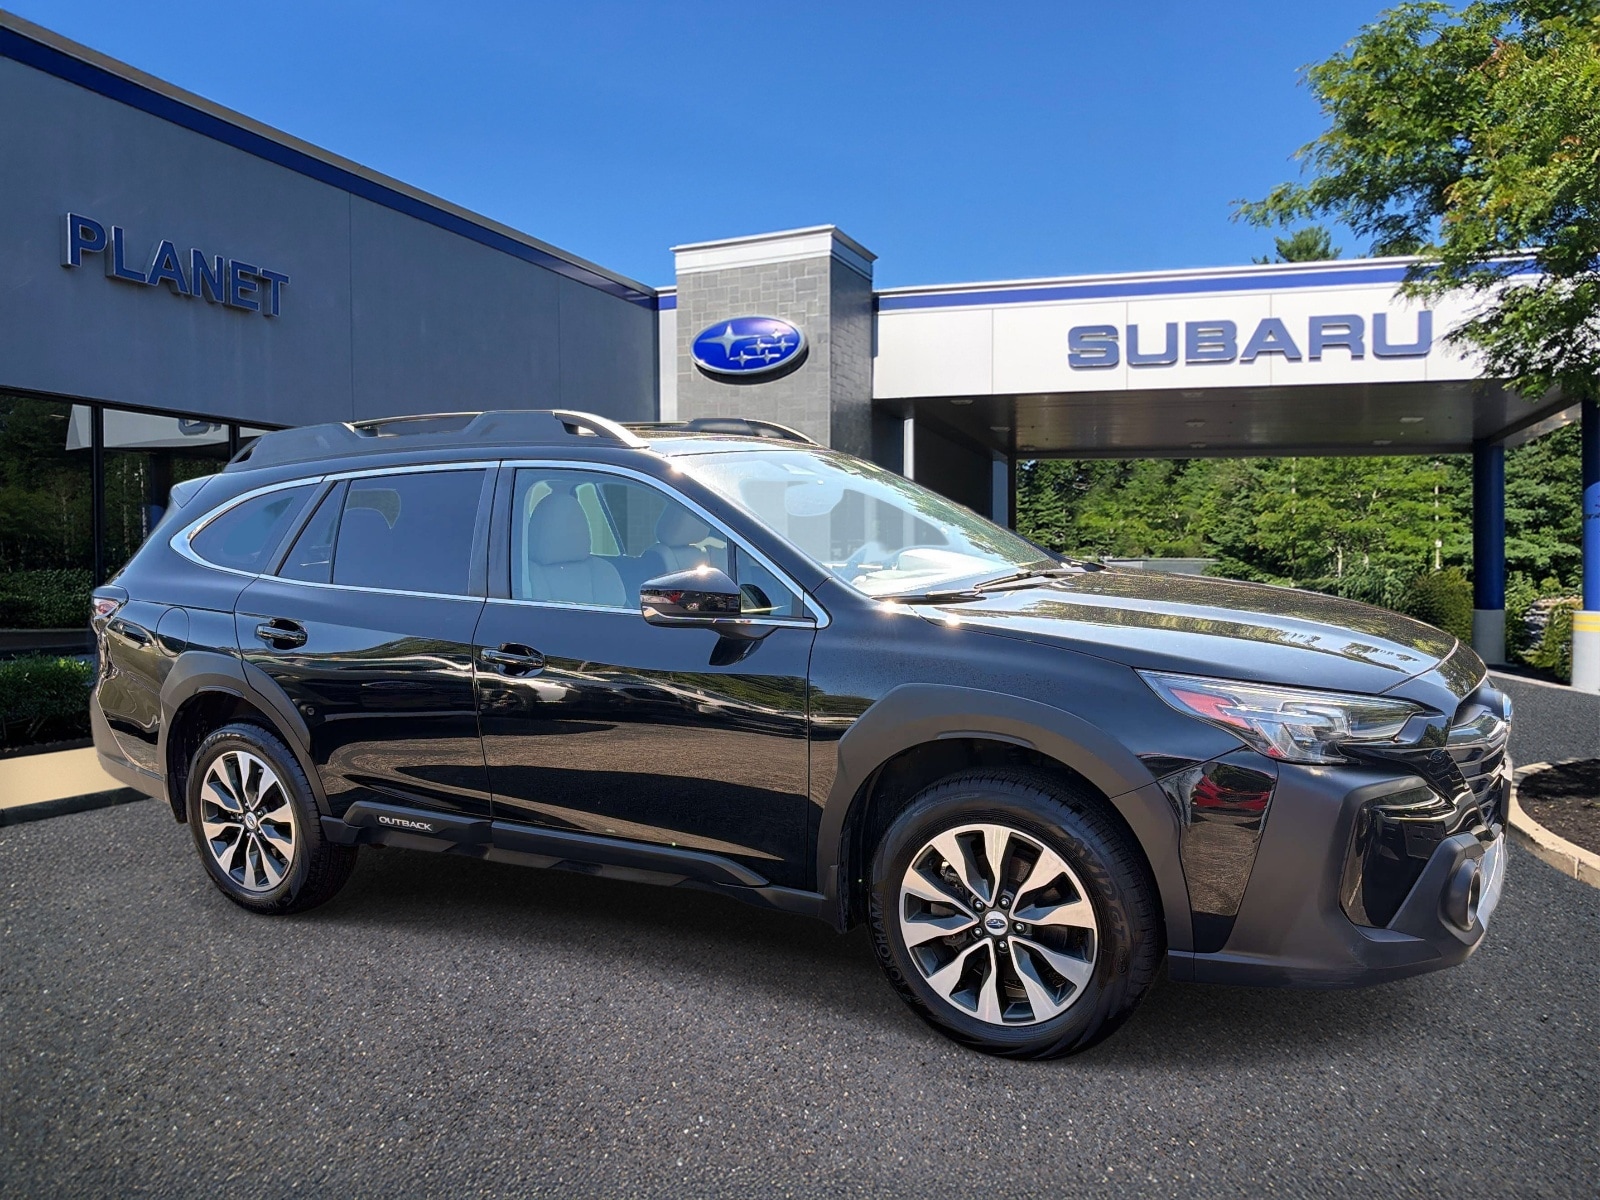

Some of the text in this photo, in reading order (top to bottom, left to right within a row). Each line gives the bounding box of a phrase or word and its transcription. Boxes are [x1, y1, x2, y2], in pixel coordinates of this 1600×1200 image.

[62, 211, 290, 317] PLANET
[1068, 310, 1432, 369] SUBARU
[379, 816, 432, 832] OUTBACK
